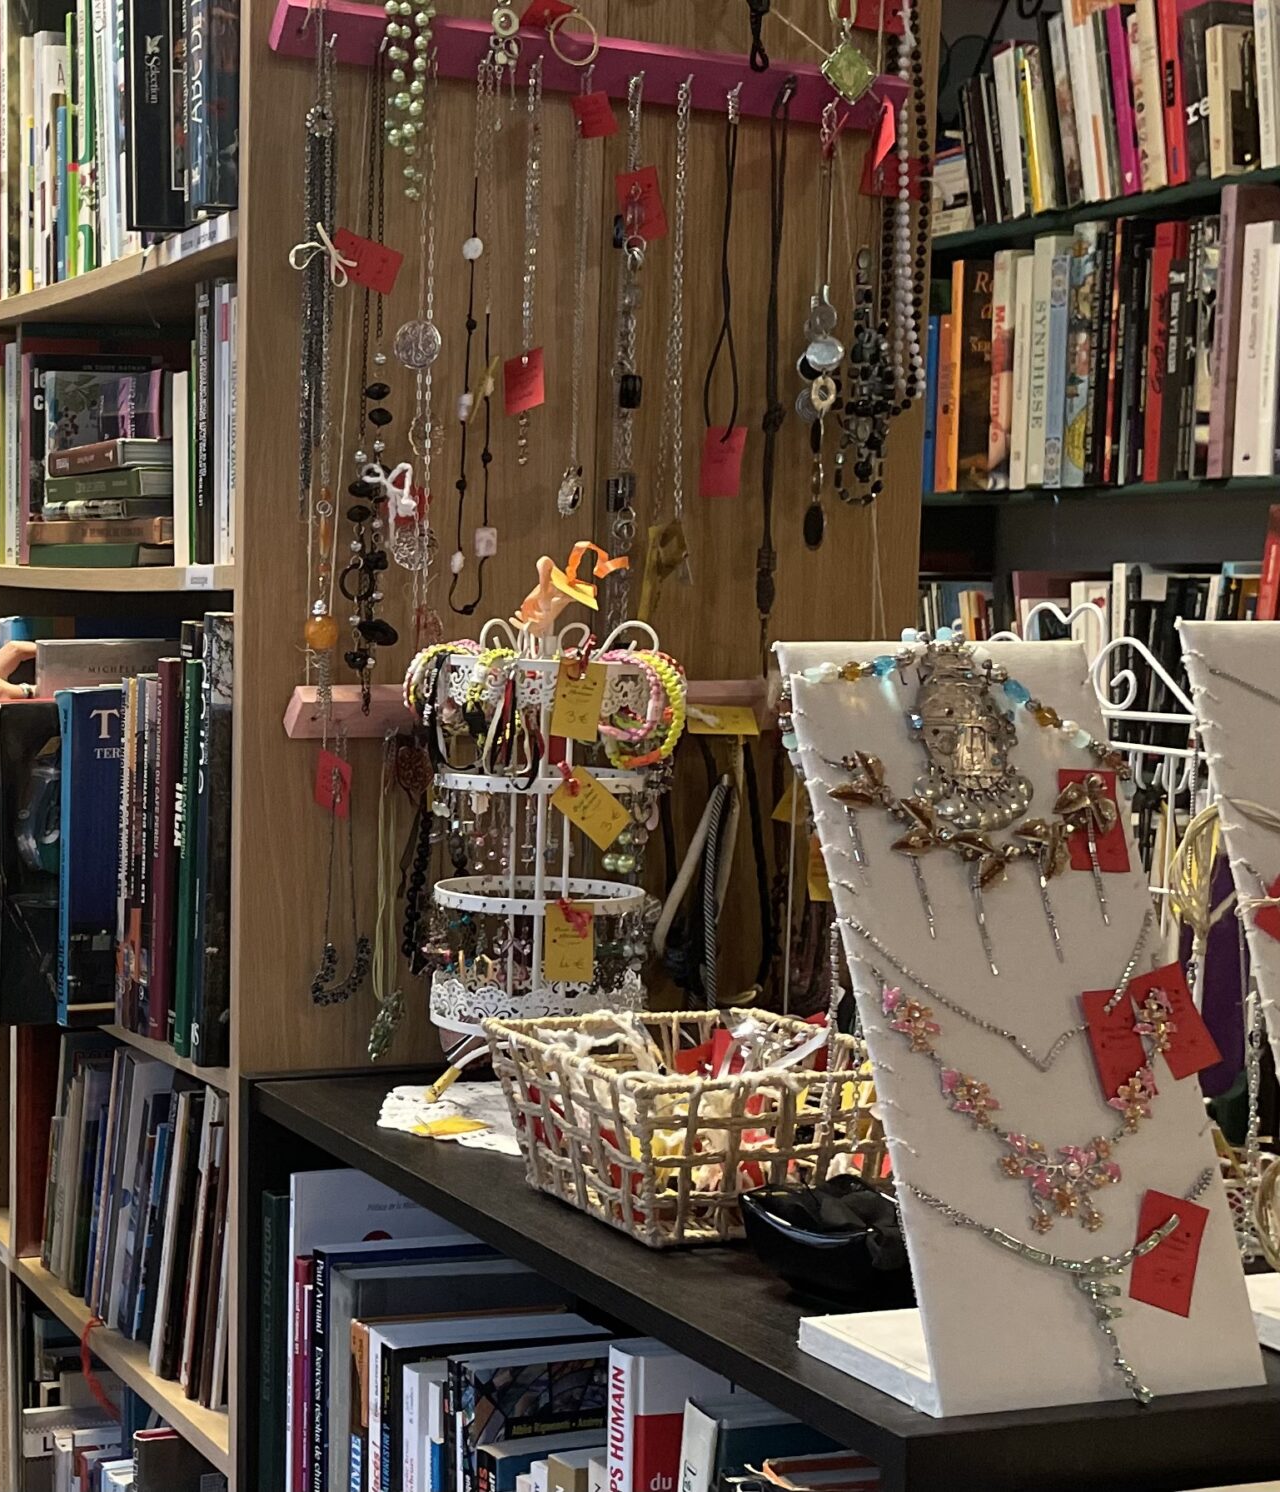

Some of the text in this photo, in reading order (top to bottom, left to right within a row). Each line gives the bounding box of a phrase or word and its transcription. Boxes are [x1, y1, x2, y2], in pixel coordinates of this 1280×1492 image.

[191, 11, 203, 124] ABC DE
[566, 709, 577, 724] 3
[154, 769, 160, 784] DU
[172, 781, 184, 848] INCA
[262, 1215, 272, 1278] FUTUR
[313, 1259, 325, 1460] Paul Arnaud Exercices résolus de
[610, 1365, 625, 1462] HUMAIN
[650, 1471, 674, 1491] du
